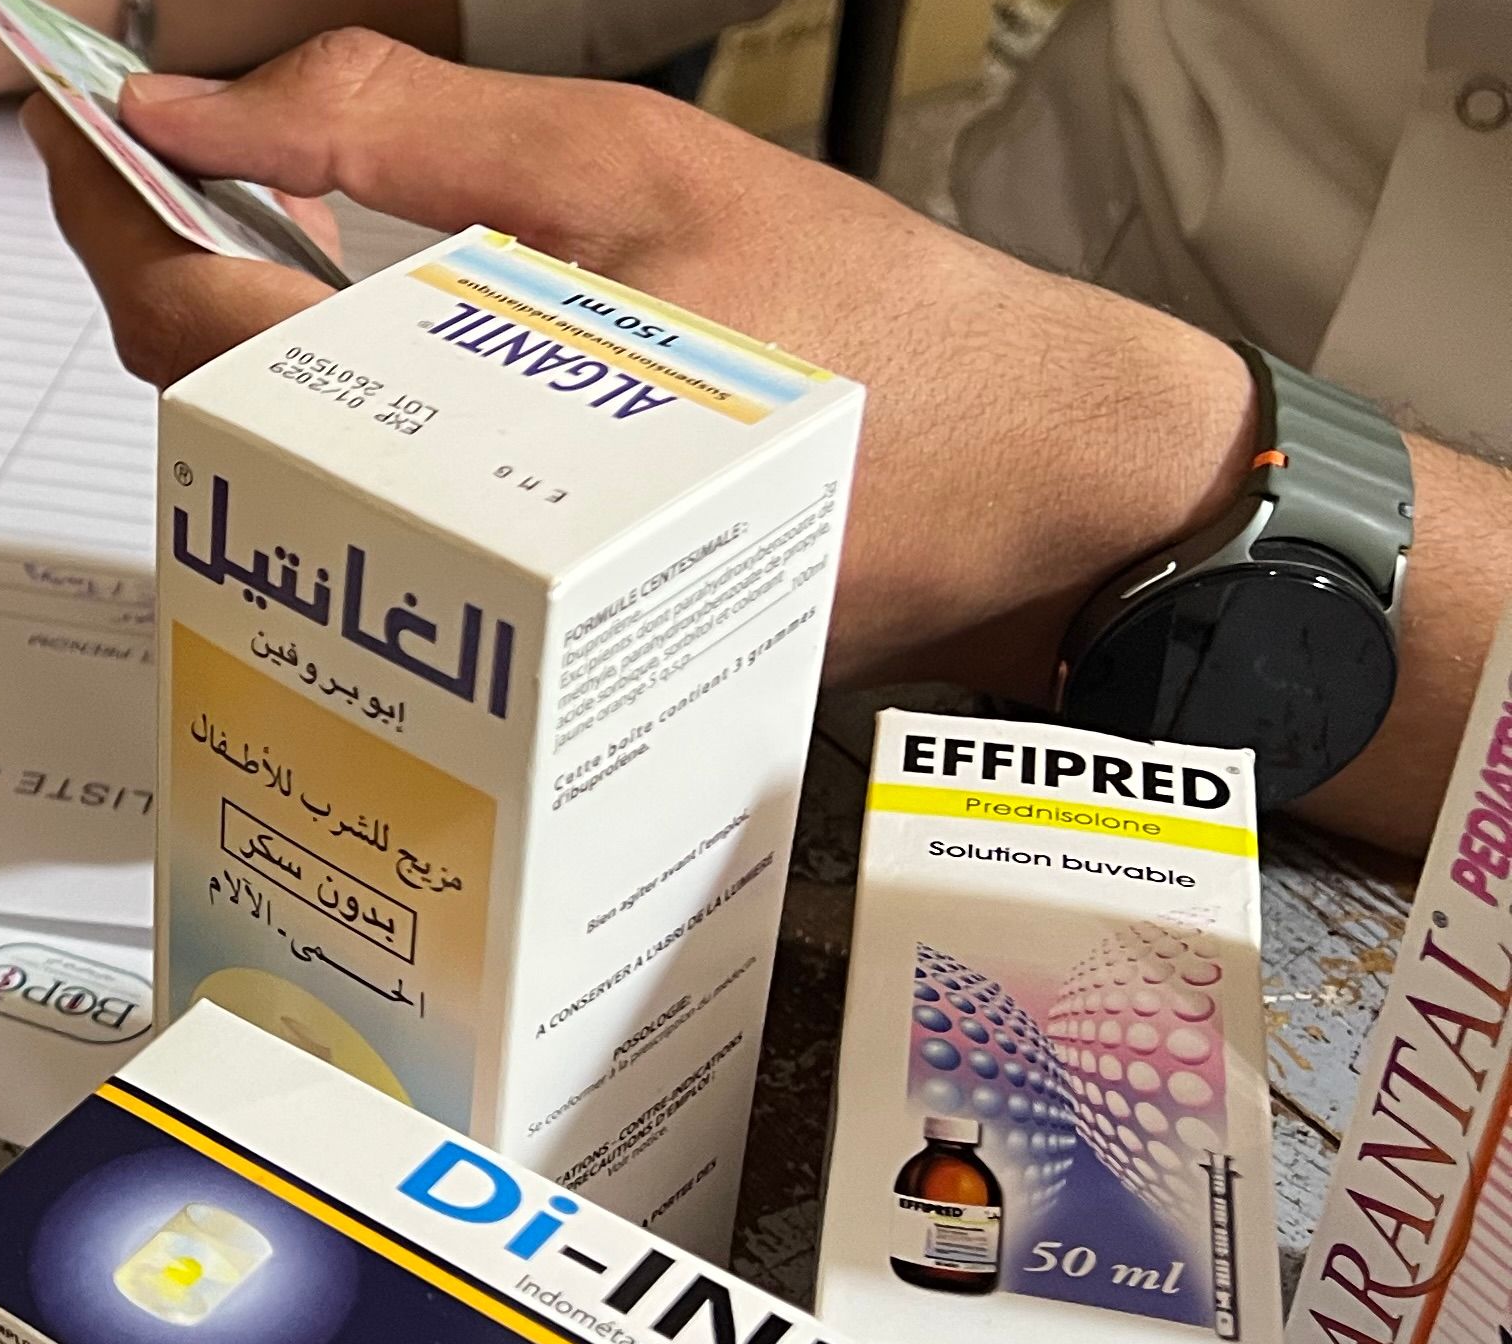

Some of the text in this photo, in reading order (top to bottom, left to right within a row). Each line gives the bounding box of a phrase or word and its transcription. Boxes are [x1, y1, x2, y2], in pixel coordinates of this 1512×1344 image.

[457, 279, 730, 400] Suspension buvable pédiatrique
[562, 294, 678, 347] 150 ml
[286, 347, 439, 422] LOT 2601500
[431, 304, 673, 418] ALGANTIL
[269, 362, 423, 435] EXP 01/2029
[171, 476, 516, 720] الغانتيل
[565, 589, 636, 644] FORMULE
[554, 755, 601, 791] Cette
[658, 668, 728, 723] contient
[17, 771, 153, 814] LISTE
[191, 714, 462, 896] مزيج للشرب للأطفال
[904, 736, 1229, 808] EFFIPRED
[966, 797, 1160, 835] Prednisolone
[239, 834, 394, 942] بدون سكر
[929, 840, 1195, 888] Solution buvable
[1021, 1234, 1185, 1294] 50 ml
